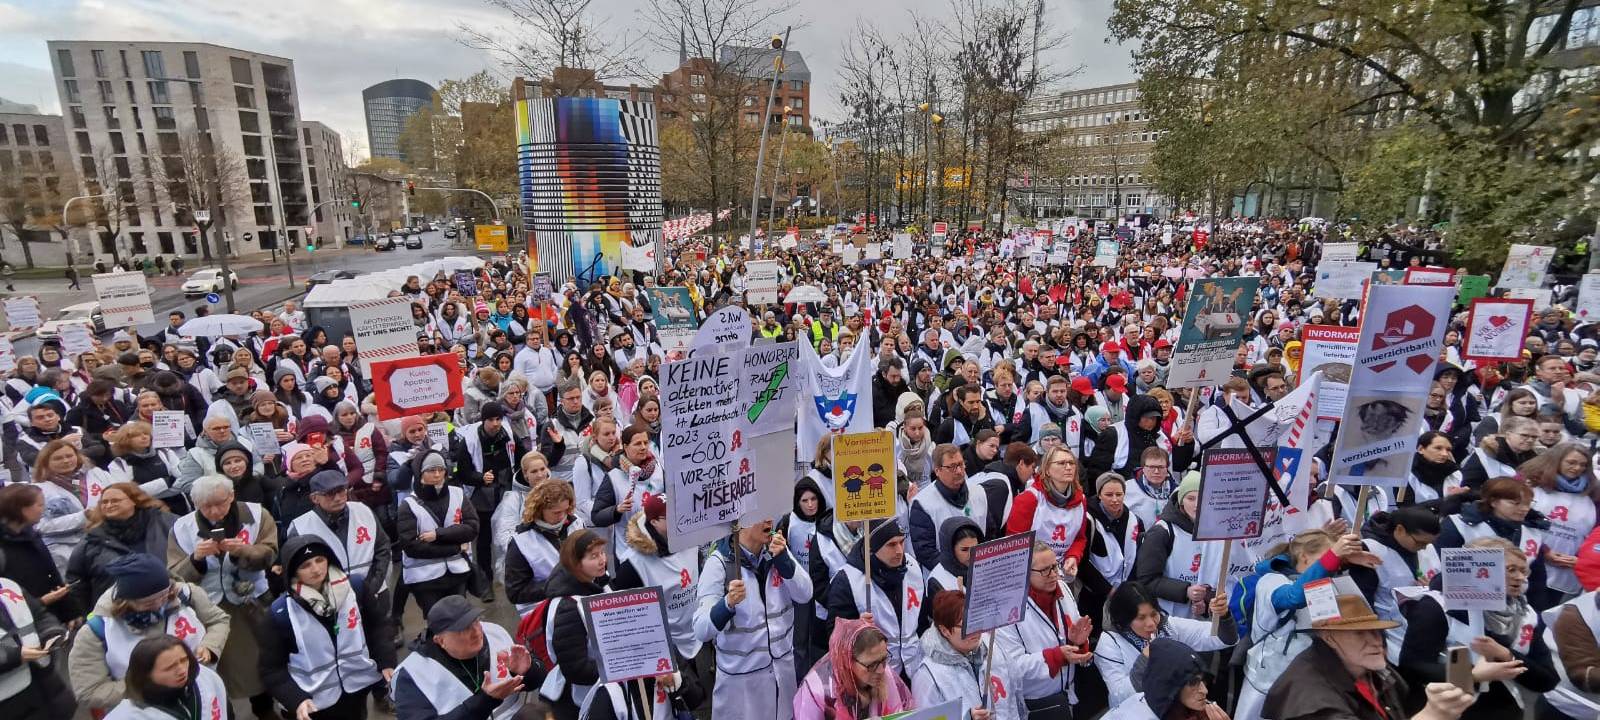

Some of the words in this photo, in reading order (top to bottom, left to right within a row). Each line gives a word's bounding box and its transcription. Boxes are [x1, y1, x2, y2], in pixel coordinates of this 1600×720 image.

[364, 316, 402, 324] APOTHEKEN
[358, 330, 370, 338] MIT
[1308, 330, 1359, 340] INFORMAT
[743, 347, 796, 368] HONORAR
[1360, 339, 1437, 365] unverzichtbar!!!
[667, 356, 730, 386] KEINE
[751, 386, 789, 403] JETZT
[668, 430, 699, 448] 2023
[1342, 445, 1392, 463] verzichtbar
[680, 460, 732, 488] VOR-ORT
[692, 472, 757, 512] MISERABEL
[975, 537, 1031, 558] INFORMATION
[590, 592, 658, 609] INFORMATION
